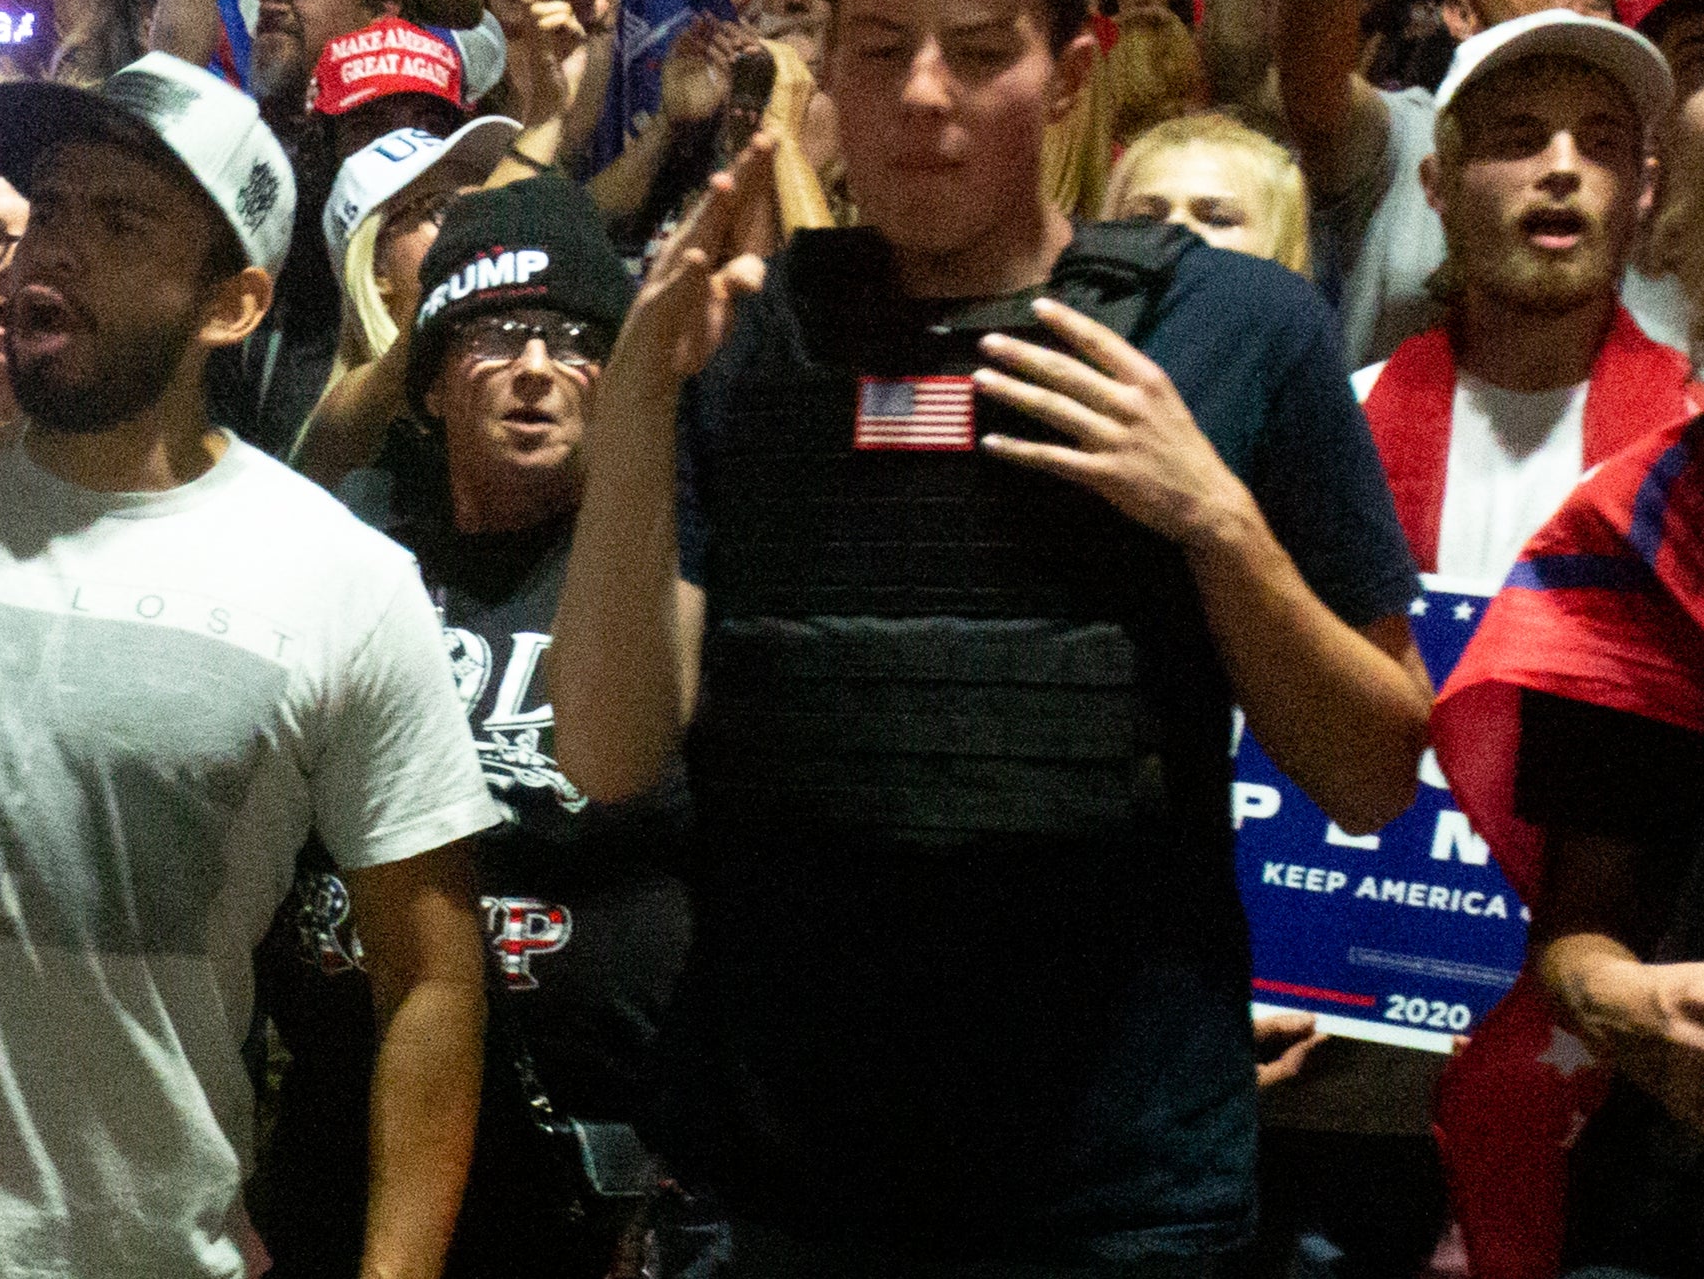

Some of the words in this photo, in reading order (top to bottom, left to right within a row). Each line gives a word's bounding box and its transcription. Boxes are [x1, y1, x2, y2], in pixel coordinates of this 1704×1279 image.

[331, 30, 384, 63] MAKE
[384, 26, 460, 71] AMERICA
[341, 53, 401, 84] GREAT
[401, 56, 450, 90] AGAIN
[71, 584, 295, 660] LOST
[1262, 861, 1348, 895] KEEP
[1356, 875, 1509, 921] AMERICA
[1384, 992, 1472, 1032] 2020
